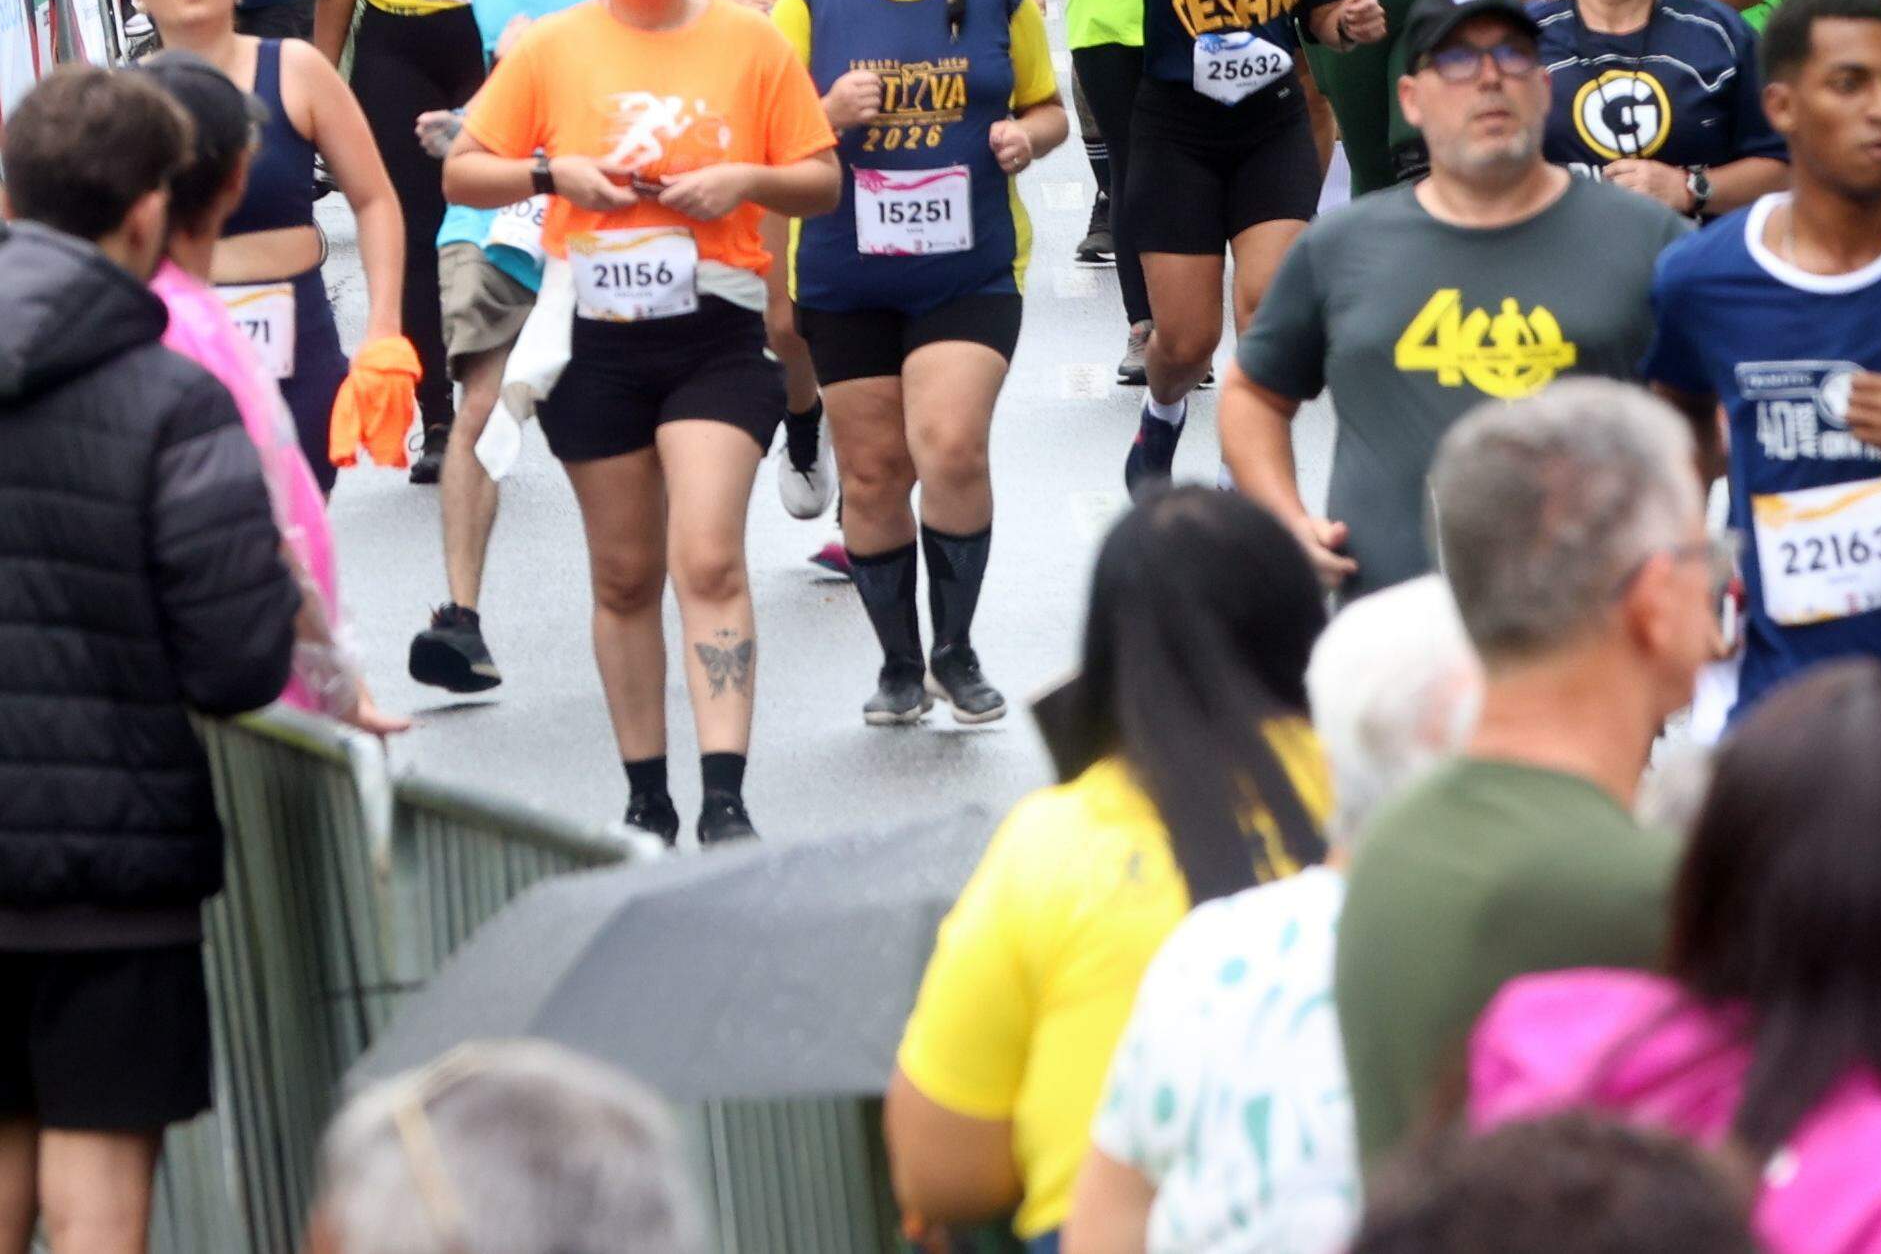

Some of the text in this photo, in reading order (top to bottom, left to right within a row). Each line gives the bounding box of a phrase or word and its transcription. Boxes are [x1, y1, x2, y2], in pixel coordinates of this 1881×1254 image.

[1207, 53, 1282, 81] 25632
[862, 124, 944, 152] 2026
[877, 198, 952, 225] 15251
[592, 259, 674, 289] 21156
